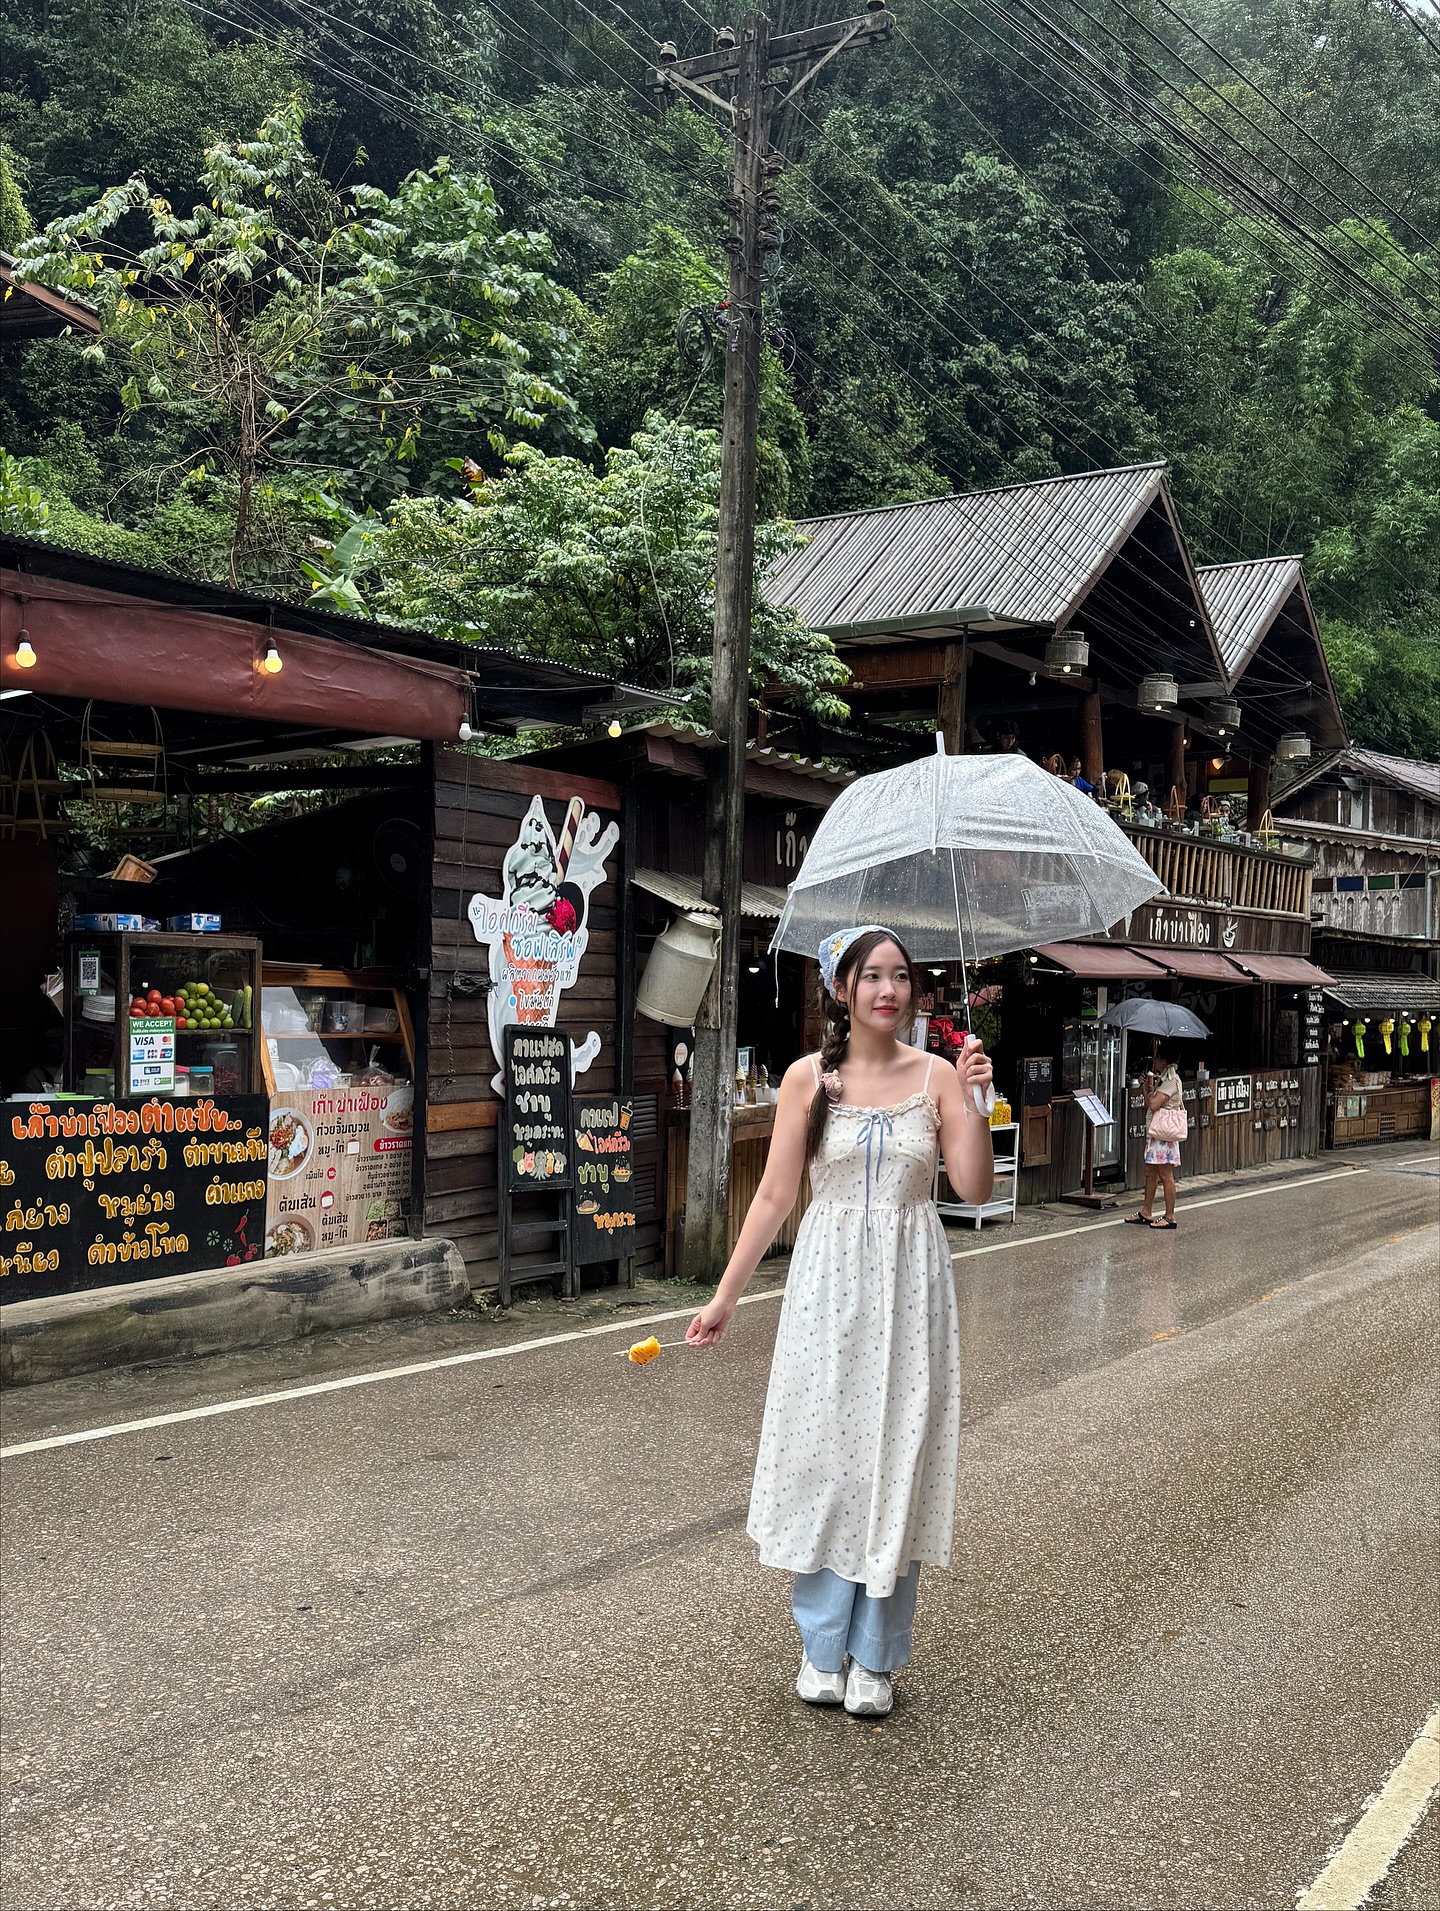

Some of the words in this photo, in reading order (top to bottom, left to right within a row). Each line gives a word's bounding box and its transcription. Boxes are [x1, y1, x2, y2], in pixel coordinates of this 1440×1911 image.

[134, 1036, 154, 1046] VISA
[515, 1091, 552, 1121] ชาบู
[580, 1102, 619, 1129] กาแฟ
[183, 1127, 268, 1167] ตำขนมจีน
[512, 1123, 564, 1148] หมูกระทะ
[578, 1162, 609, 1194] ชาบู
[99, 1184, 175, 1226] หมูย่าง
[279, 1193, 316, 1212] ต้มเส้น
[322, 1212, 348, 1226] ต้มเส้น
[88, 1222, 189, 1266] ตำข้าวโพด
